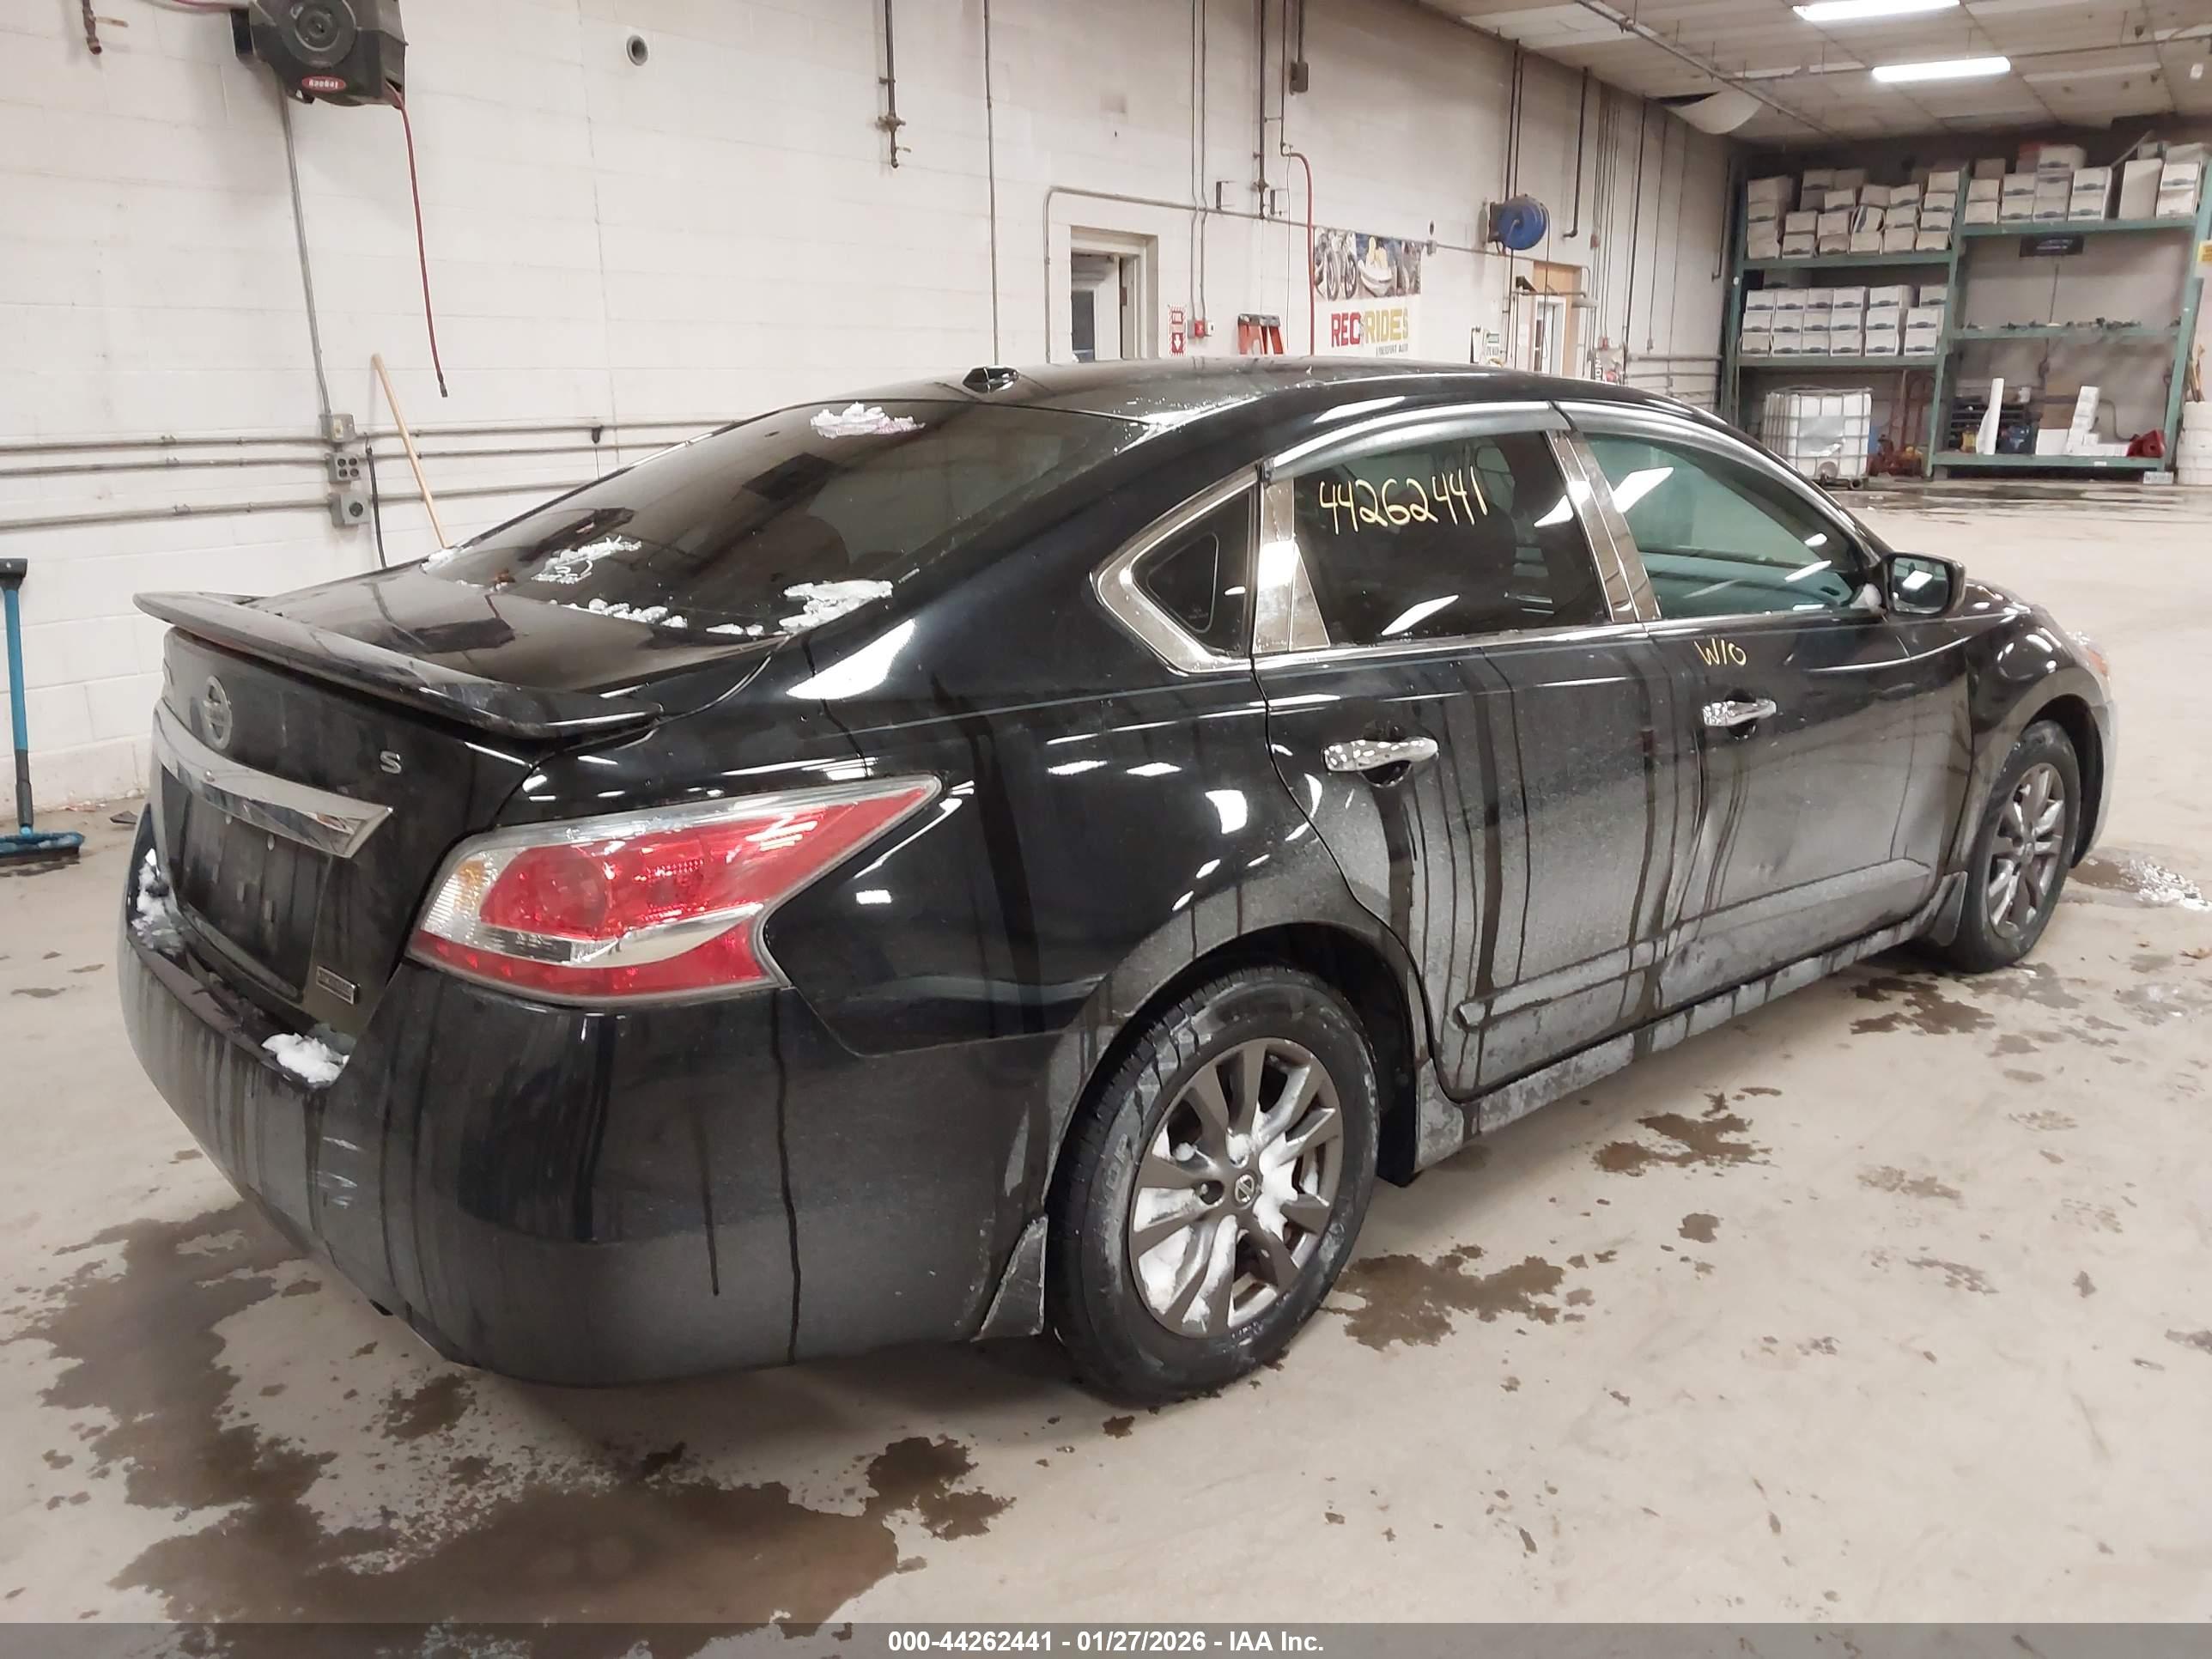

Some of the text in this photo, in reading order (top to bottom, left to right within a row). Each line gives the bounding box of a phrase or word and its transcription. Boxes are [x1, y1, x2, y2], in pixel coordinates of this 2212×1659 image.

[1331, 307, 1409, 348] REC RIDES
[1319, 465, 1489, 535] 44262441
[380, 750, 402, 775] S
